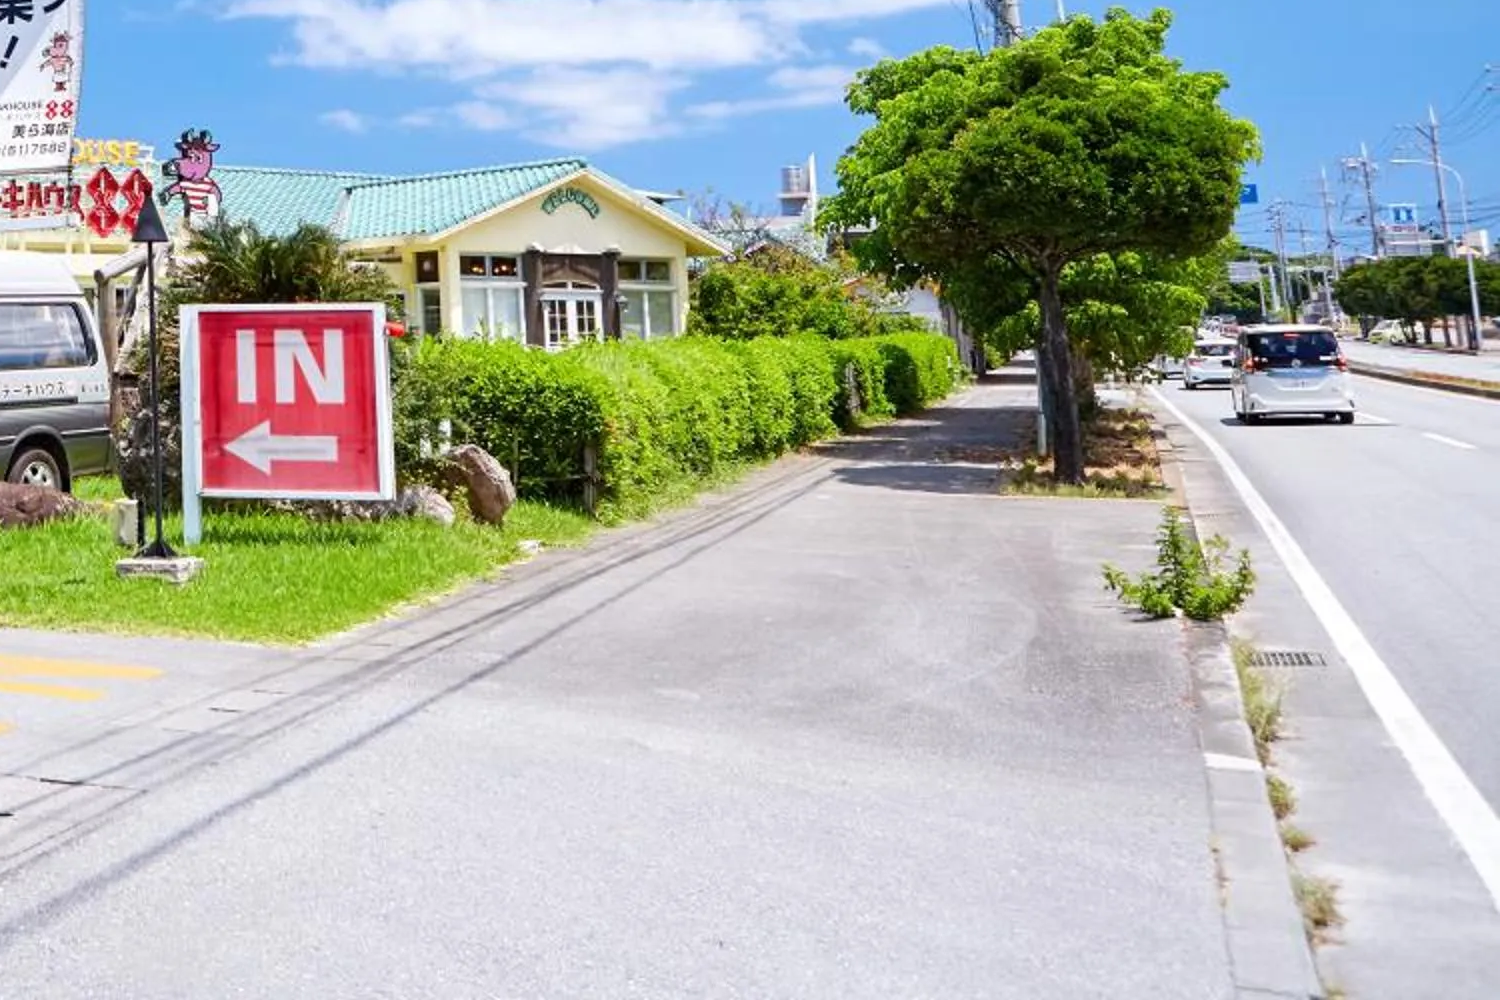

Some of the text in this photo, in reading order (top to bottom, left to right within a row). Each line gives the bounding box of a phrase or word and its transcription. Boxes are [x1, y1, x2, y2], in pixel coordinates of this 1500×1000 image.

[45, 99, 74, 120] 88
[12, 122, 71, 138] 美ら海店
[236, 328, 346, 405] IN
